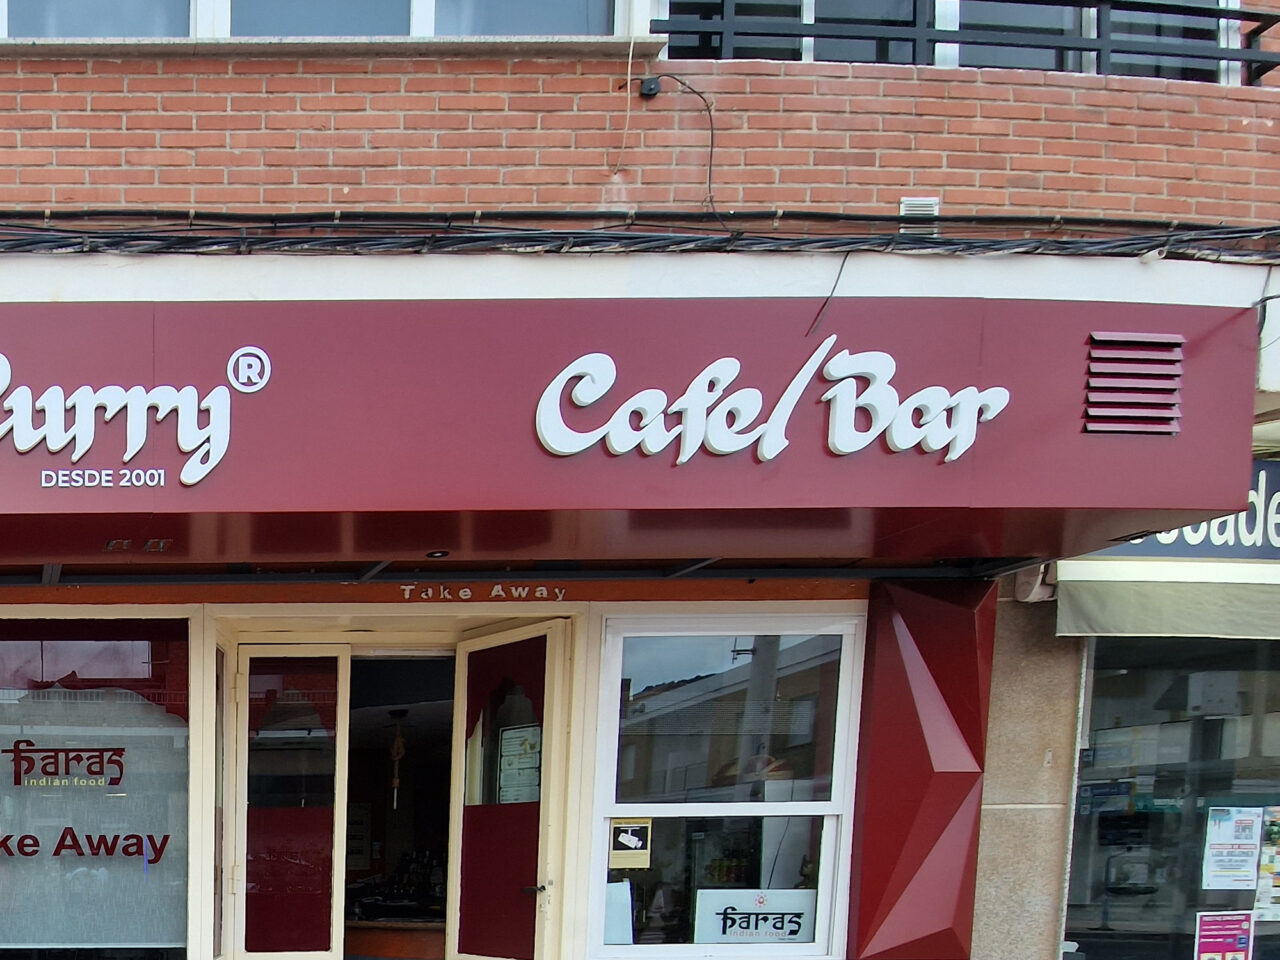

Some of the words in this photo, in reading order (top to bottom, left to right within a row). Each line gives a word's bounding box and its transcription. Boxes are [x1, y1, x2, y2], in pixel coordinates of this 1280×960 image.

[40, 469, 114, 487] DESDE
[118, 468, 165, 487] 2001
[400, 584, 472, 600] Take
[489, 584, 566, 601] Away
[24, 777, 69, 787] indian
[74, 777, 105, 787] food
[52, 827, 171, 865] Away
